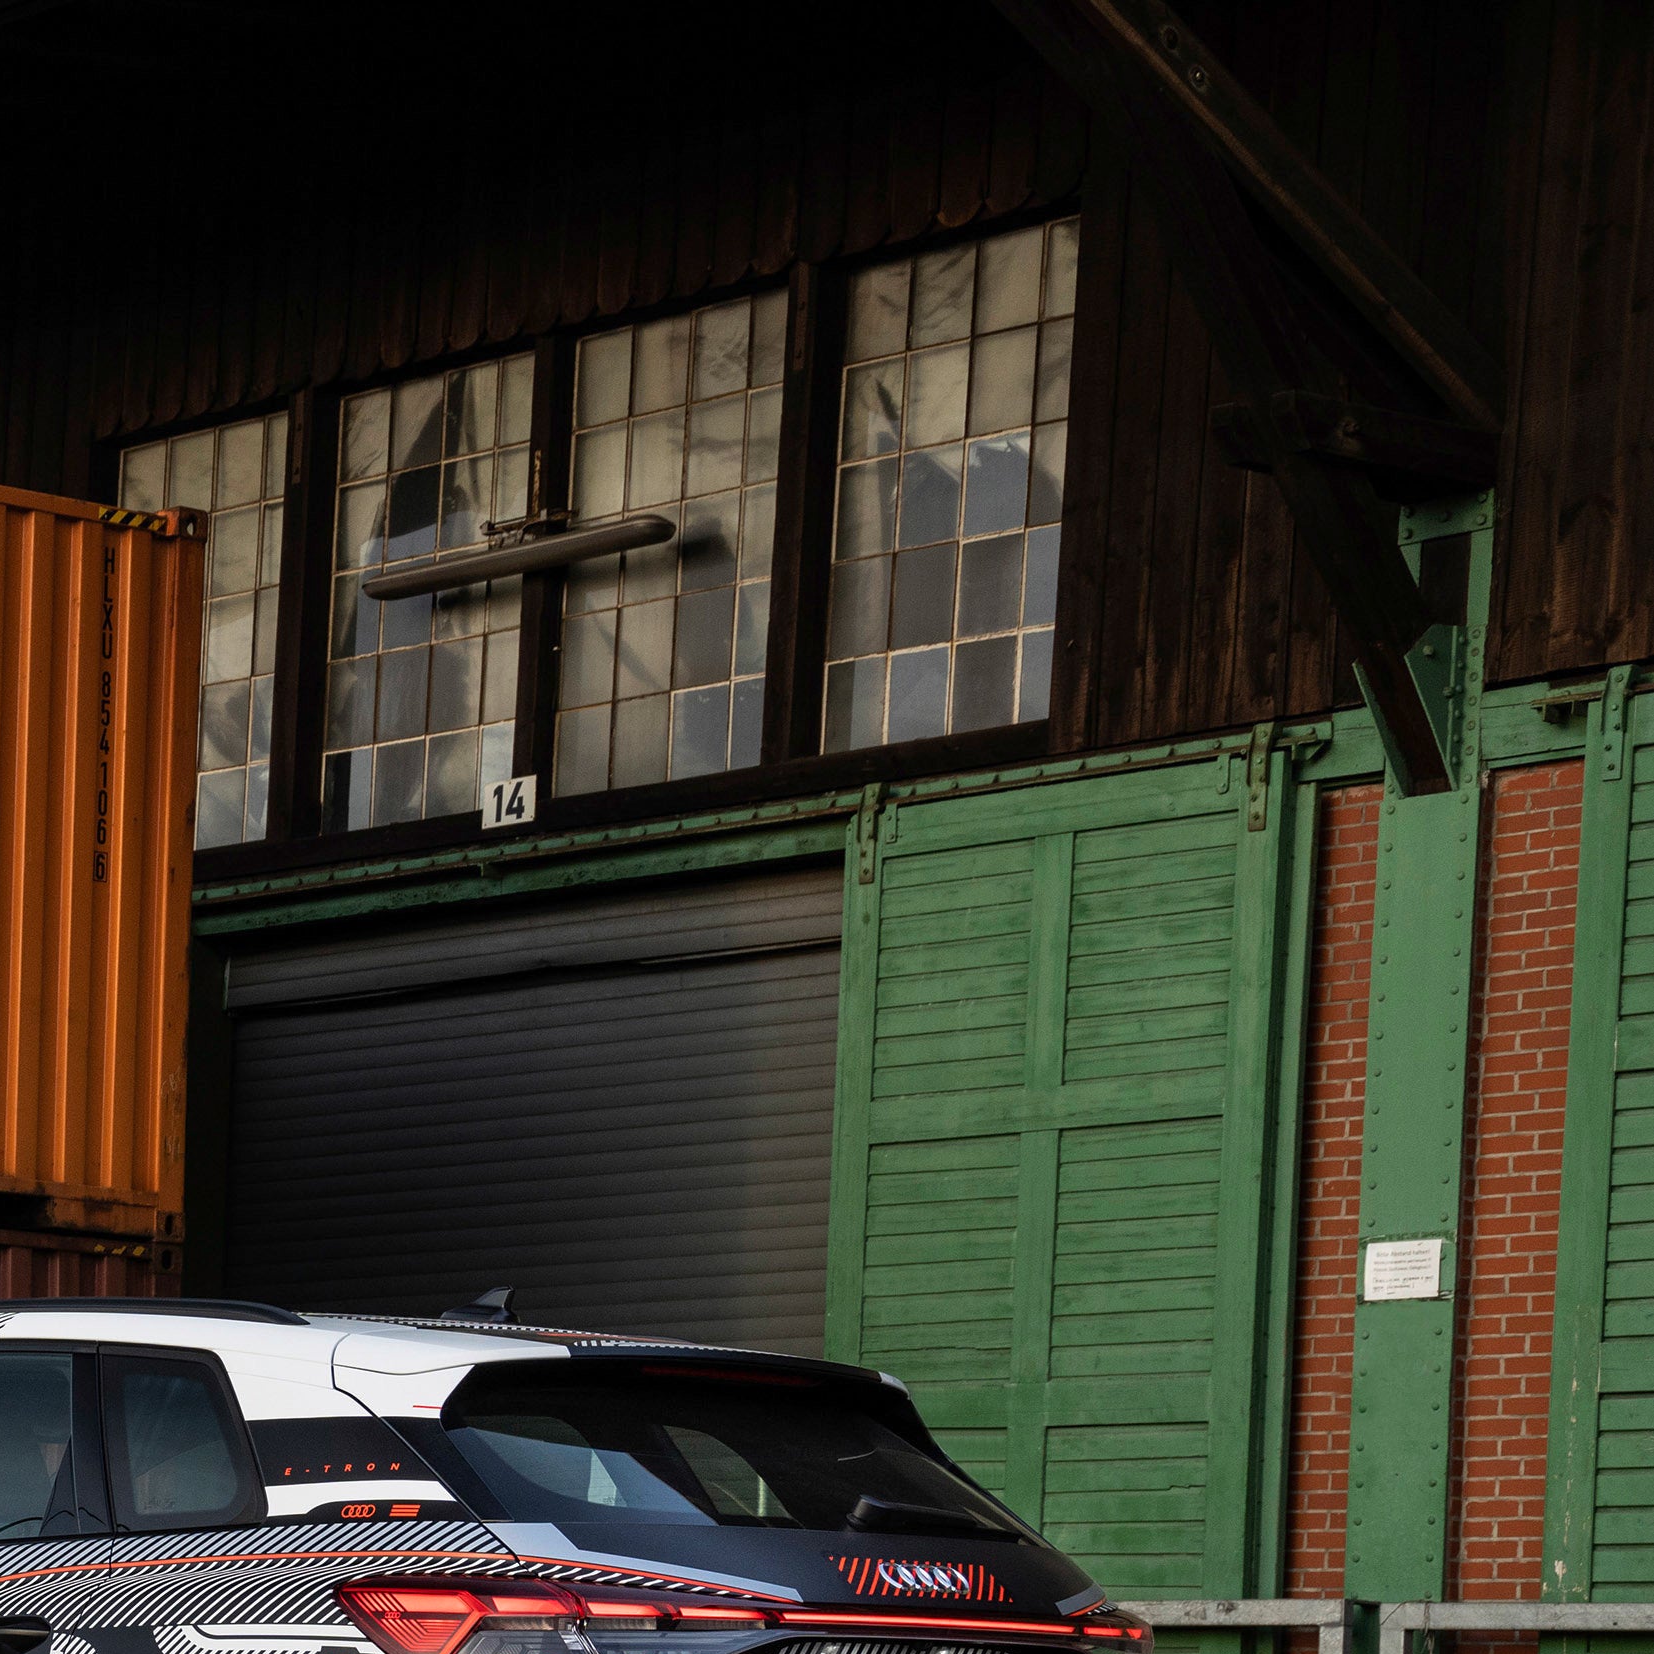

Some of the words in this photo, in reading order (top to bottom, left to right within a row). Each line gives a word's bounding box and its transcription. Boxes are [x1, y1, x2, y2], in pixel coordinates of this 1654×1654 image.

[102, 547, 115, 659] HLXU
[96, 671, 111, 846] 854106
[493, 781, 525, 823] 14
[284, 1462, 401, 1476] E-TRON
